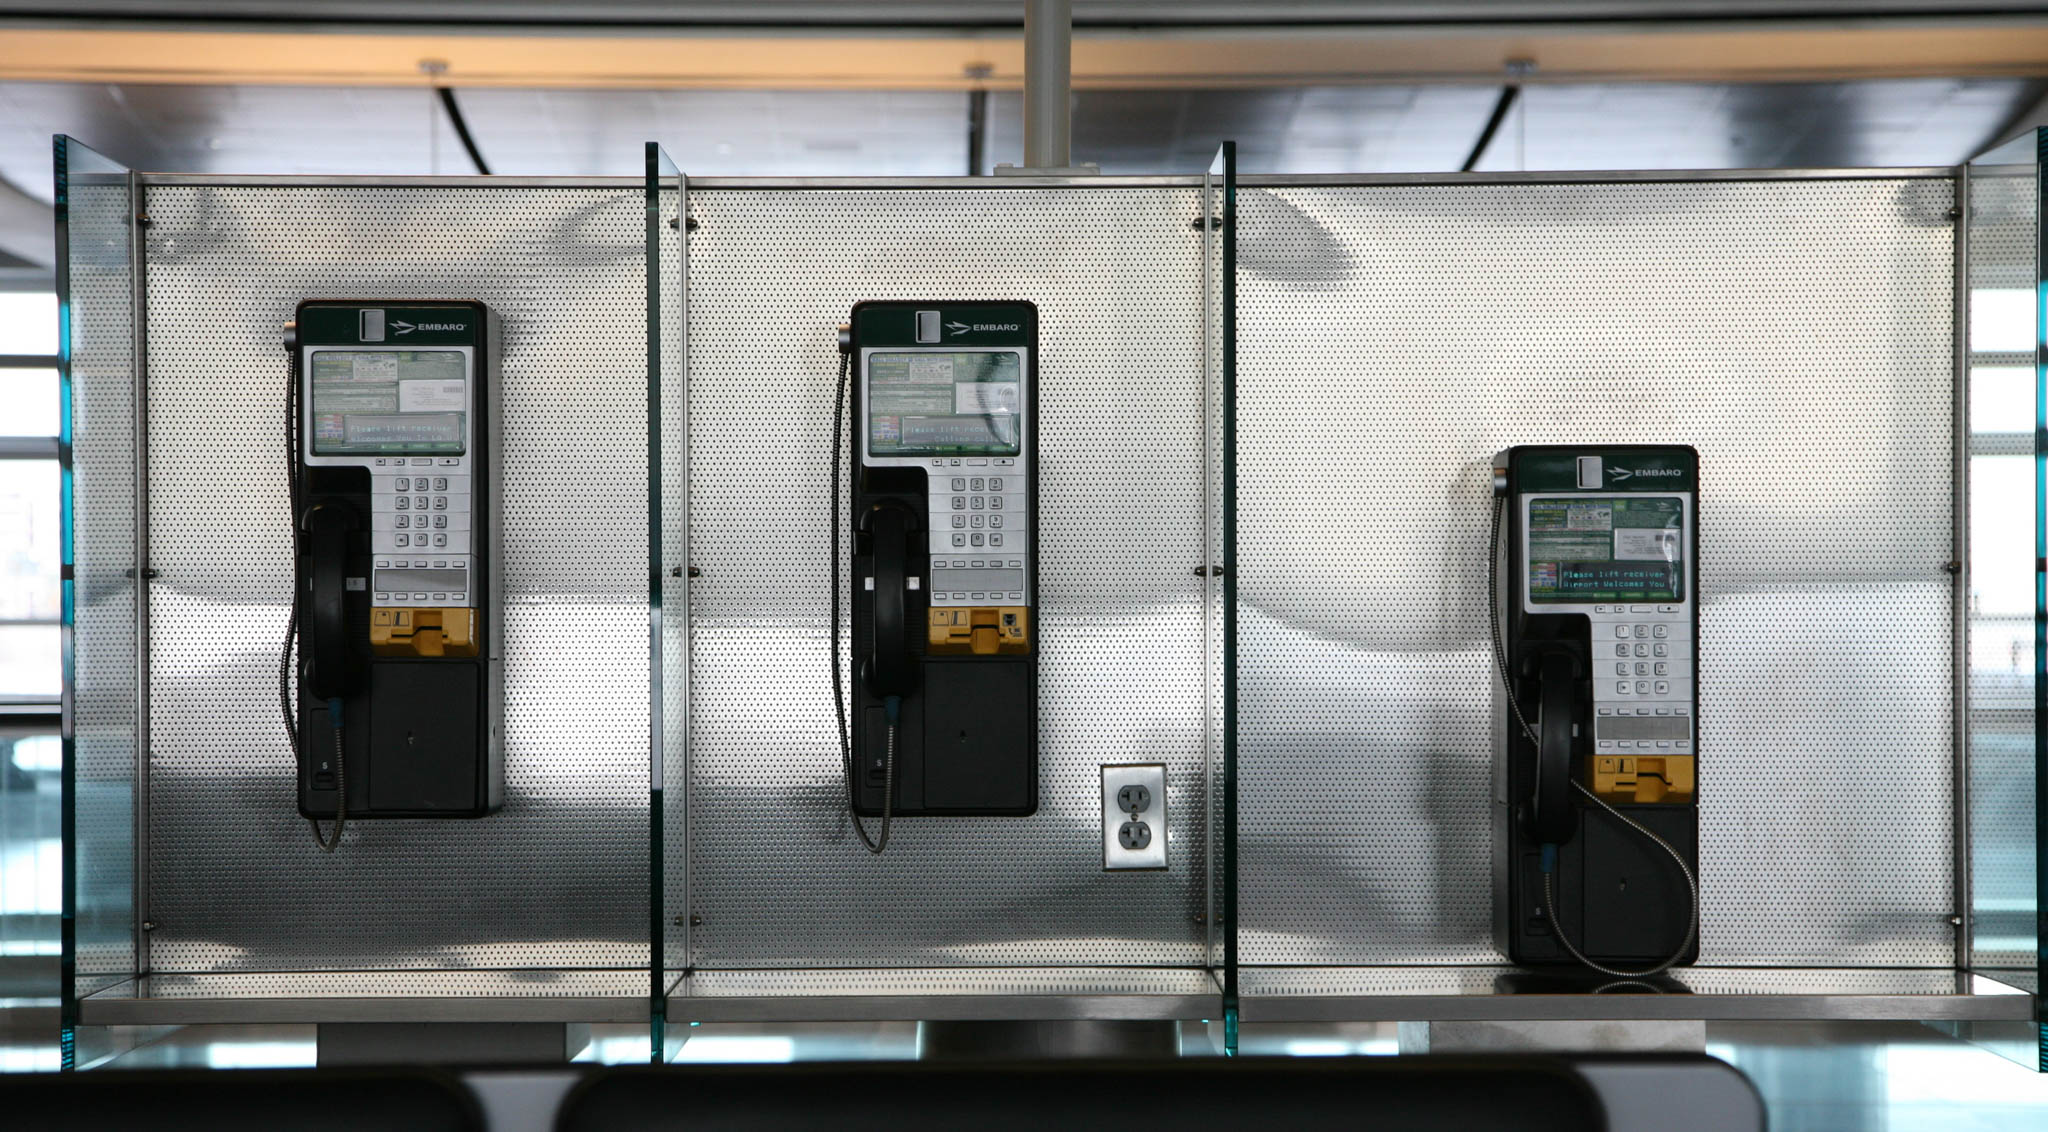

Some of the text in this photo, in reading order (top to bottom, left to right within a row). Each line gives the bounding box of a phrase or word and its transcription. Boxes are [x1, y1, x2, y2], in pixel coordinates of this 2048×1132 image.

[417, 323, 465, 331] EMBARQ
[972, 323, 1019, 331] EMBARQ
[1635, 469, 1682, 477] EMBARQ
[1562, 570, 1665, 578] Please lift receiver
[1603, 580, 1645, 588] Welcomes
[1649, 580, 1665, 588] You
